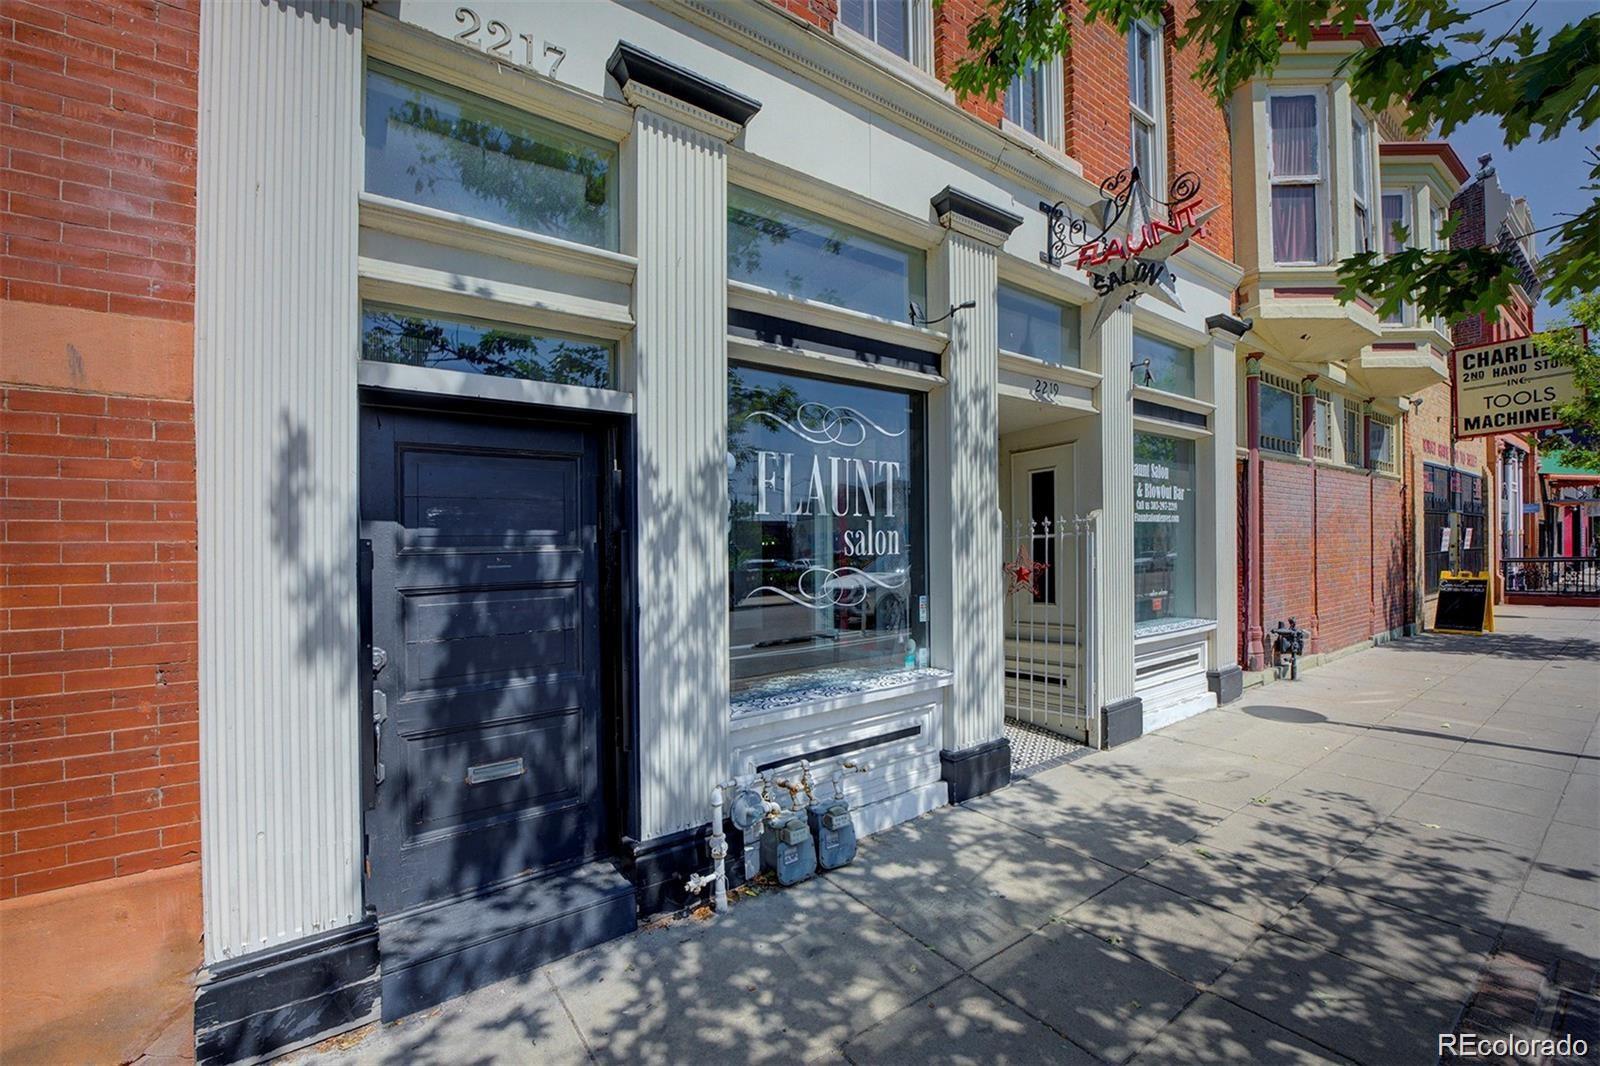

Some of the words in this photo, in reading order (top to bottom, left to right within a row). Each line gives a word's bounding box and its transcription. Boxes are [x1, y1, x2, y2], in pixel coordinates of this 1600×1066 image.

[454, 6, 567, 80] 2217
[1076, 199, 1203, 270] FLAUNT
[1092, 262, 1164, 297] SALON
[1463, 370, 1485, 383] 2ND
[1492, 363, 1527, 378] HAND
[1534, 359, 1563, 372] STO
[1035, 379, 1060, 397] 2219
[1484, 386, 1556, 409] TOOLS
[755, 450, 901, 518] FLAUNT
[1151, 463, 1169, 479] Salon
[1137, 482, 1143, 497] &
[1173, 485, 1185, 501] Bar
[843, 519, 901, 557] salon
